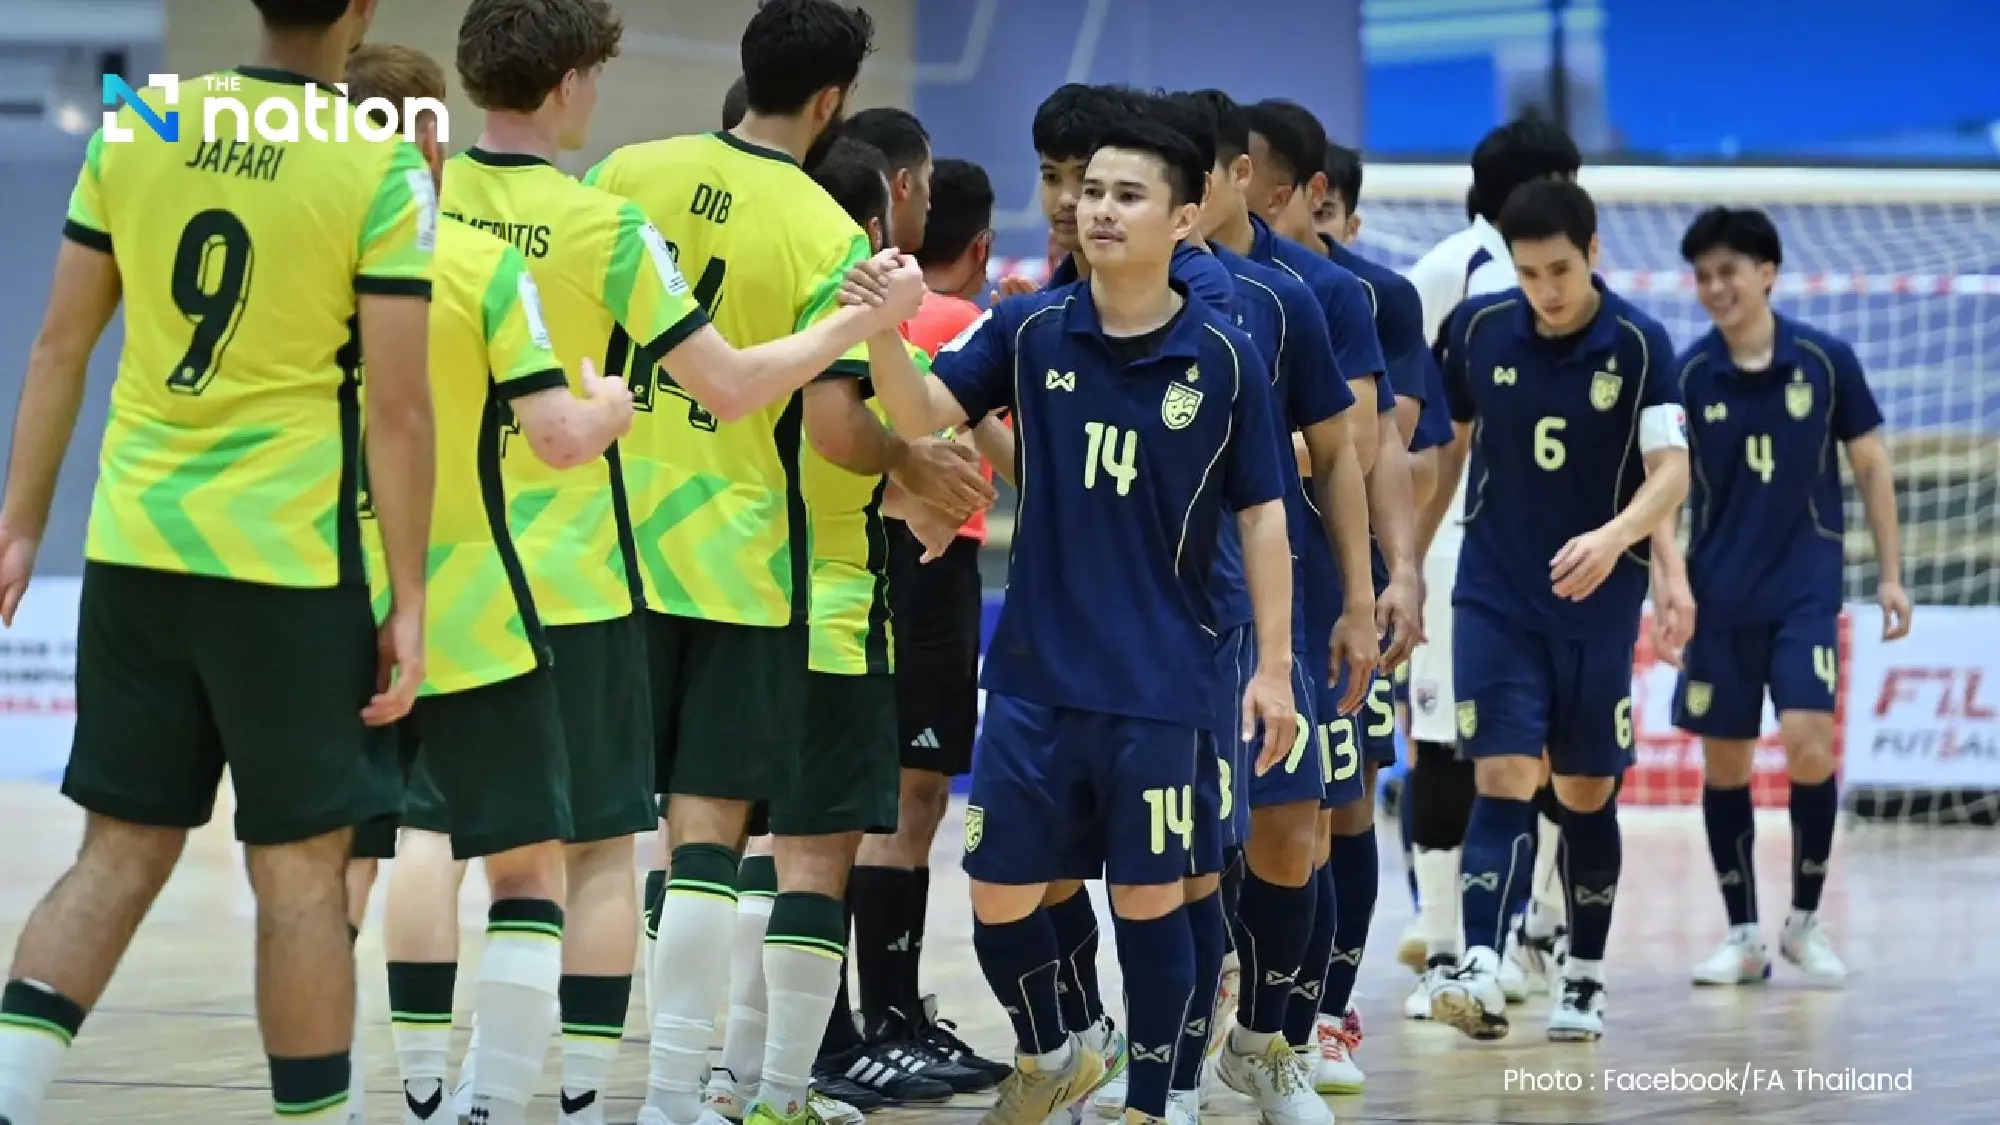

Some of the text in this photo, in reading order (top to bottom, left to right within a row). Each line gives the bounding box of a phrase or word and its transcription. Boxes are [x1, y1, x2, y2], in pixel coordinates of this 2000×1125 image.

[185, 137, 286, 182] JAFARI
[690, 183, 732, 224] DIB
[166, 208, 255, 396] 9
[1085, 422, 1138, 496] 14
[1534, 416, 1567, 471] 6
[1746, 435, 1775, 482] 4
[1812, 645, 1837, 694] 4
[1368, 680, 1394, 736] 5
[1614, 697, 1633, 749] 6
[1317, 719, 1358, 783] 13
[1143, 785, 1194, 855] 14
